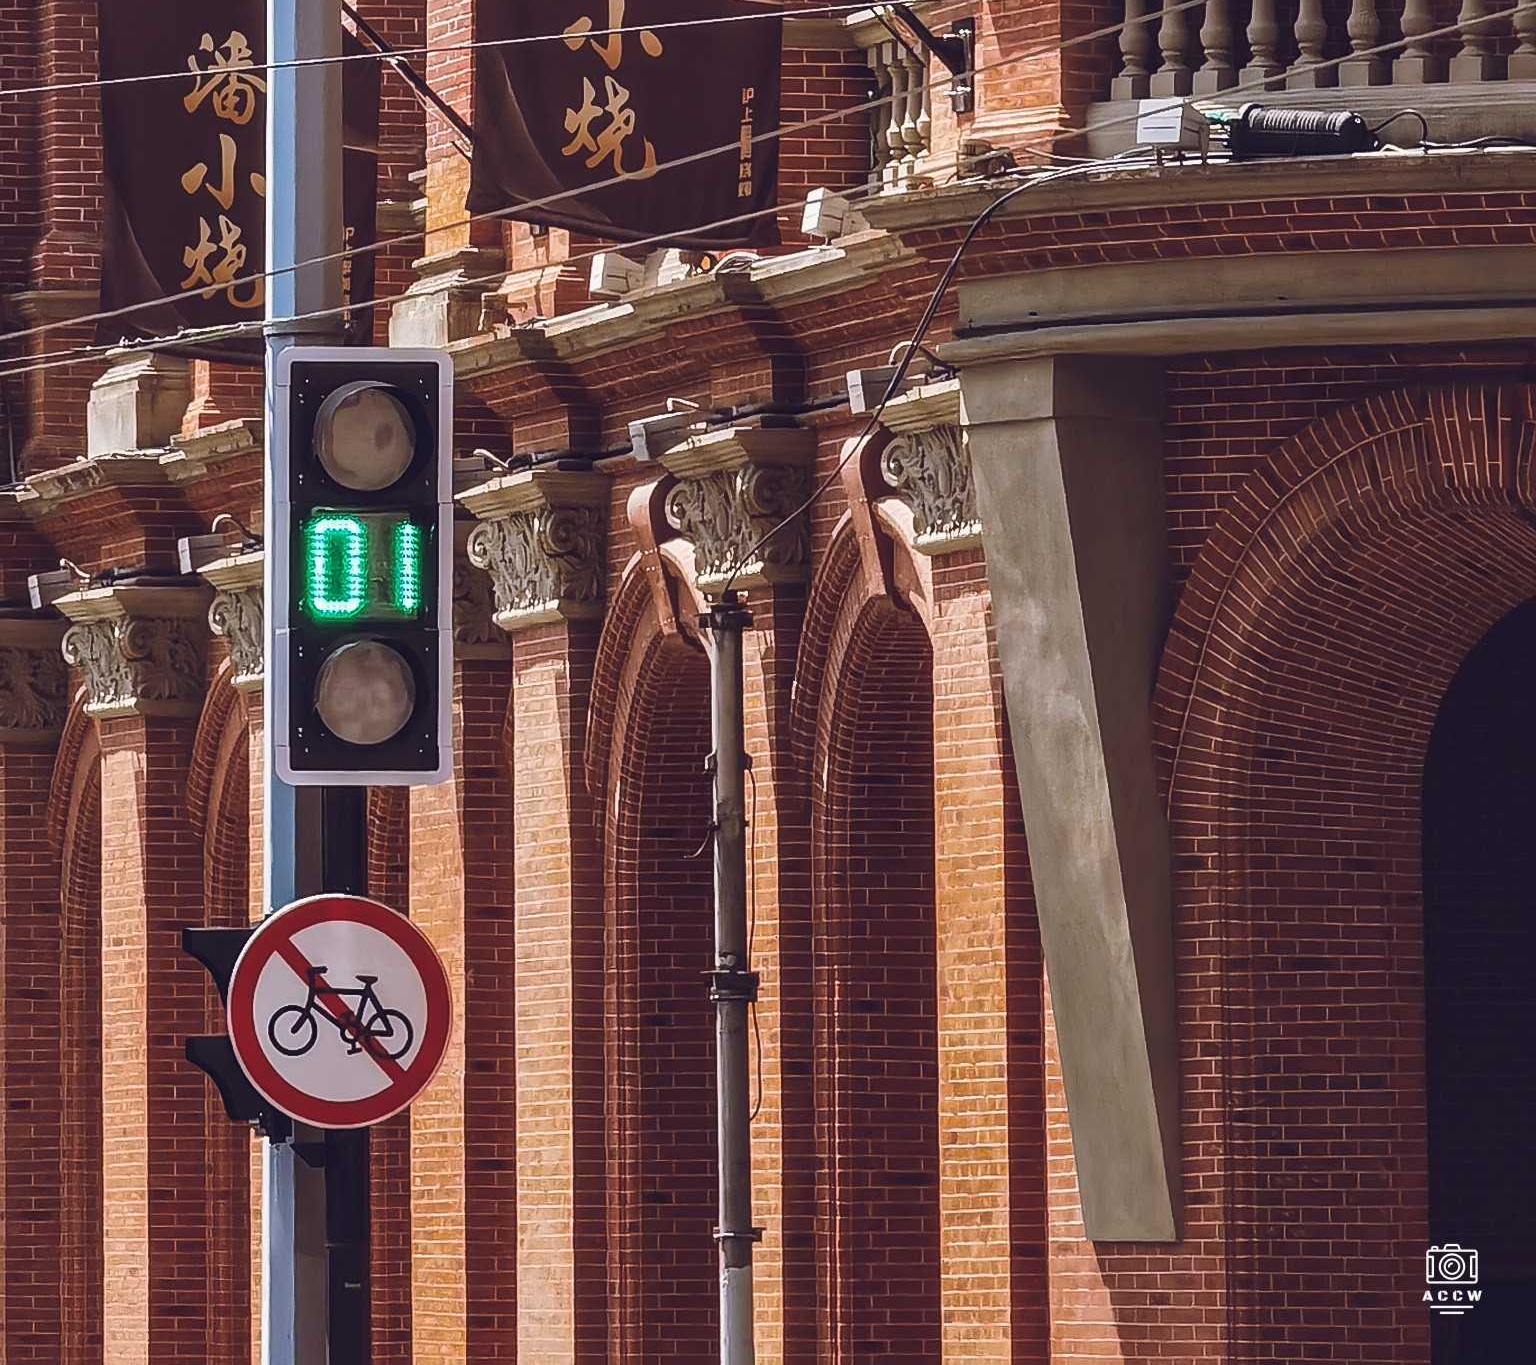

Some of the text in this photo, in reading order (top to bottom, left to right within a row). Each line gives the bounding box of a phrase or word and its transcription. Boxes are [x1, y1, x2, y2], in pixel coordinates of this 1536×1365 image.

[179, 30, 266, 309] 潘小烧
[306, 517, 421, 618] 01
